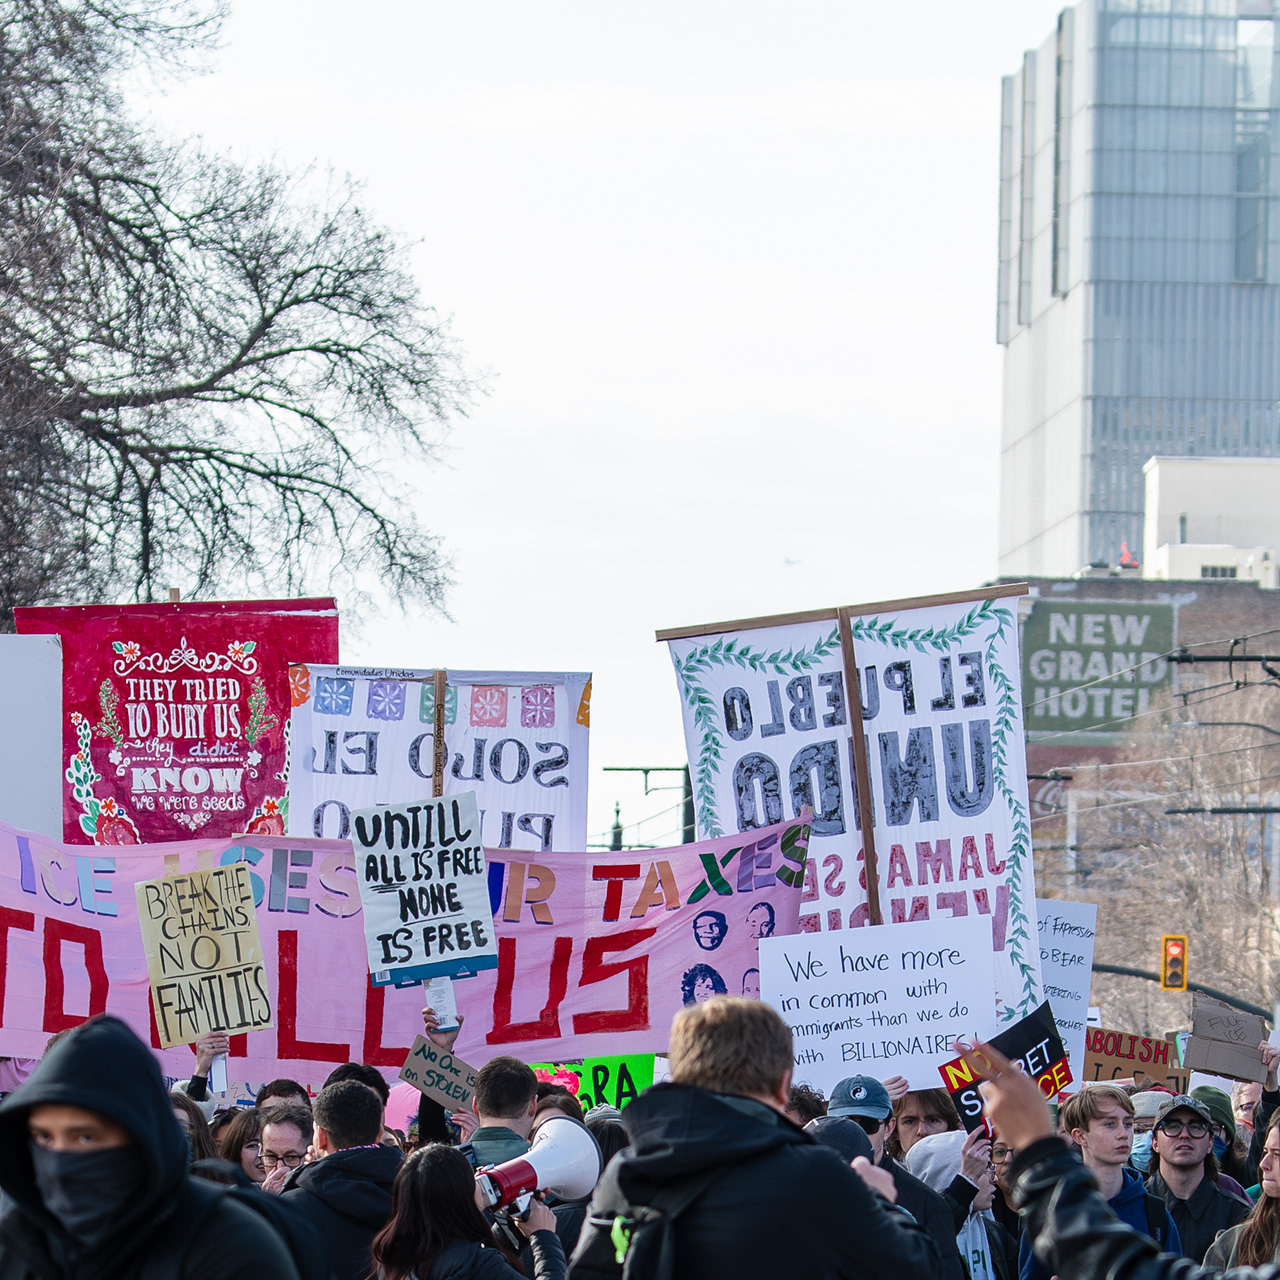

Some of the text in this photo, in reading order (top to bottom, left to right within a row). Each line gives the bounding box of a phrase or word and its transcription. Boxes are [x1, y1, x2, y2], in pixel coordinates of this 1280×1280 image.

[1048, 612, 1151, 646] NEW
[1029, 648, 1168, 682] GRAND
[126, 678, 241, 702] THEY TRIED
[125, 702, 152, 739] TO
[154, 702, 207, 740] BURY
[130, 766, 245, 794] KNOW
[131, 790, 246, 811] we were seeds
[16, 835, 119, 917] ICE
[592, 824, 812, 922] TAXES
[365, 846, 484, 883] ALL IS FREE
[146, 867, 248, 920] BREAK THE
[398, 882, 464, 923] NONE
[158, 931, 250, 975] NOT
[376, 919, 489, 965] IS FREE
[783, 945, 966, 983] We have more
[155, 965, 272, 1043] FAMILIES
[779, 978, 948, 1012] in common with
[866, 1000, 970, 1028] than we do
